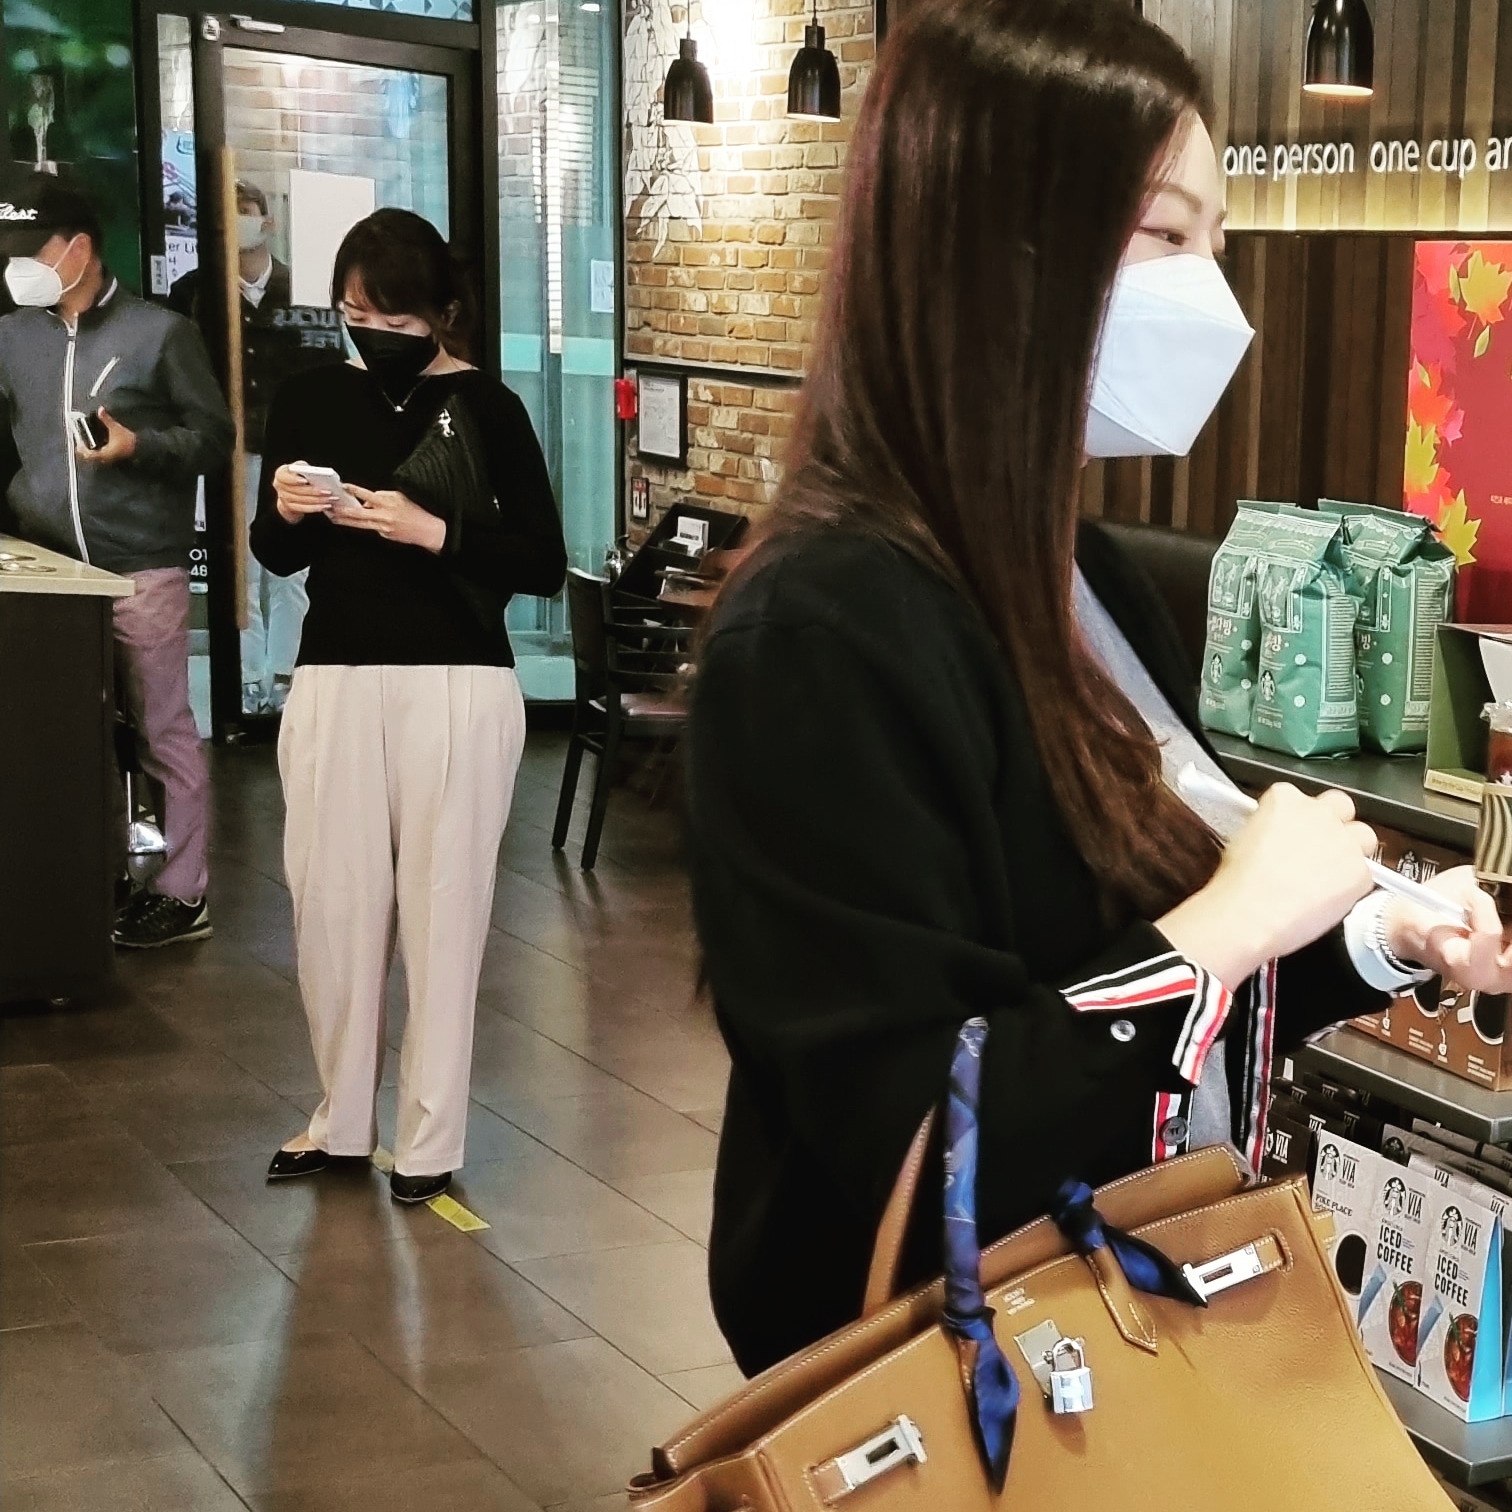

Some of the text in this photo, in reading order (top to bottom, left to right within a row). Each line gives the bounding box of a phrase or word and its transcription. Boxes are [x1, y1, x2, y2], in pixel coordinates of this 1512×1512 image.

[1222, 143, 1267, 176] one
[1273, 142, 1355, 182] person
[1369, 139, 1420, 173] one
[1426, 139, 1477, 179] cup
[1276, 1133, 1289, 1160] VIA
[1342, 1158, 1357, 1184] VIA
[1407, 1192, 1422, 1220] VIA
[1379, 1224, 1403, 1249] ICED
[1464, 1222, 1479, 1250] VIA
[1376, 1242, 1414, 1275] COFFEE
[1436, 1253, 1459, 1281] ICED
[1434, 1272, 1469, 1308] COFFEE
